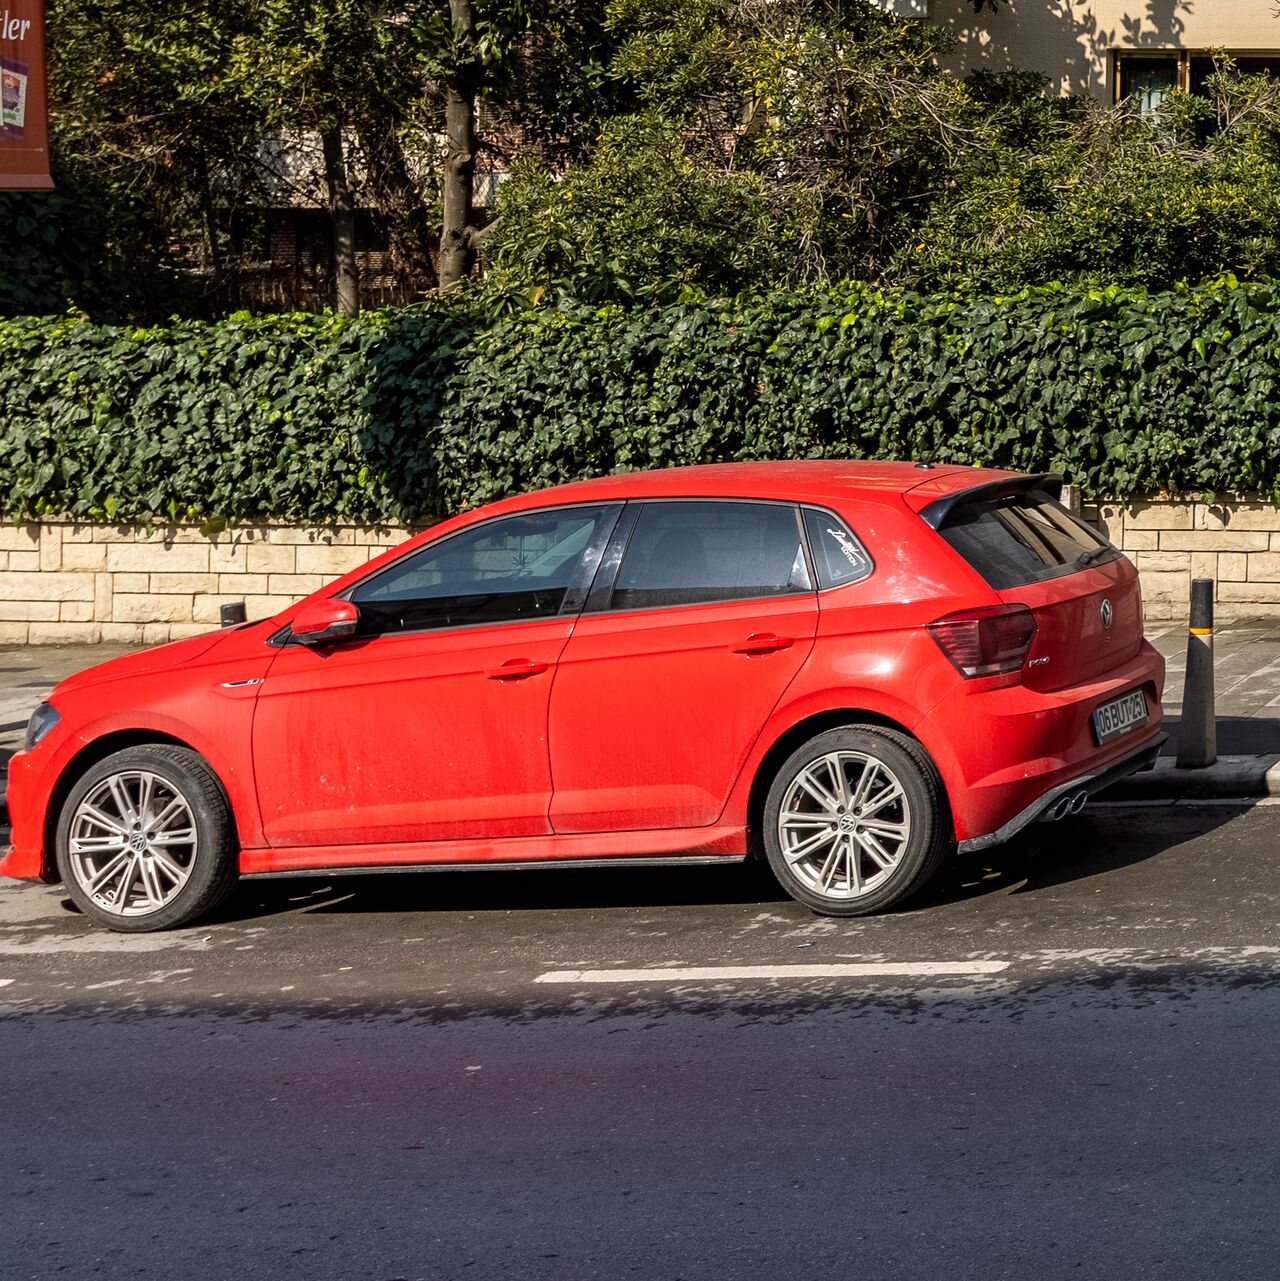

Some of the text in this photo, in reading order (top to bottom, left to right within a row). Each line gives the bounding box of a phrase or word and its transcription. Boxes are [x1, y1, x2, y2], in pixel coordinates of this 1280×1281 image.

[0, 9, 31, 41] ler
[1098, 693, 1145, 733] 06 BUT 251
